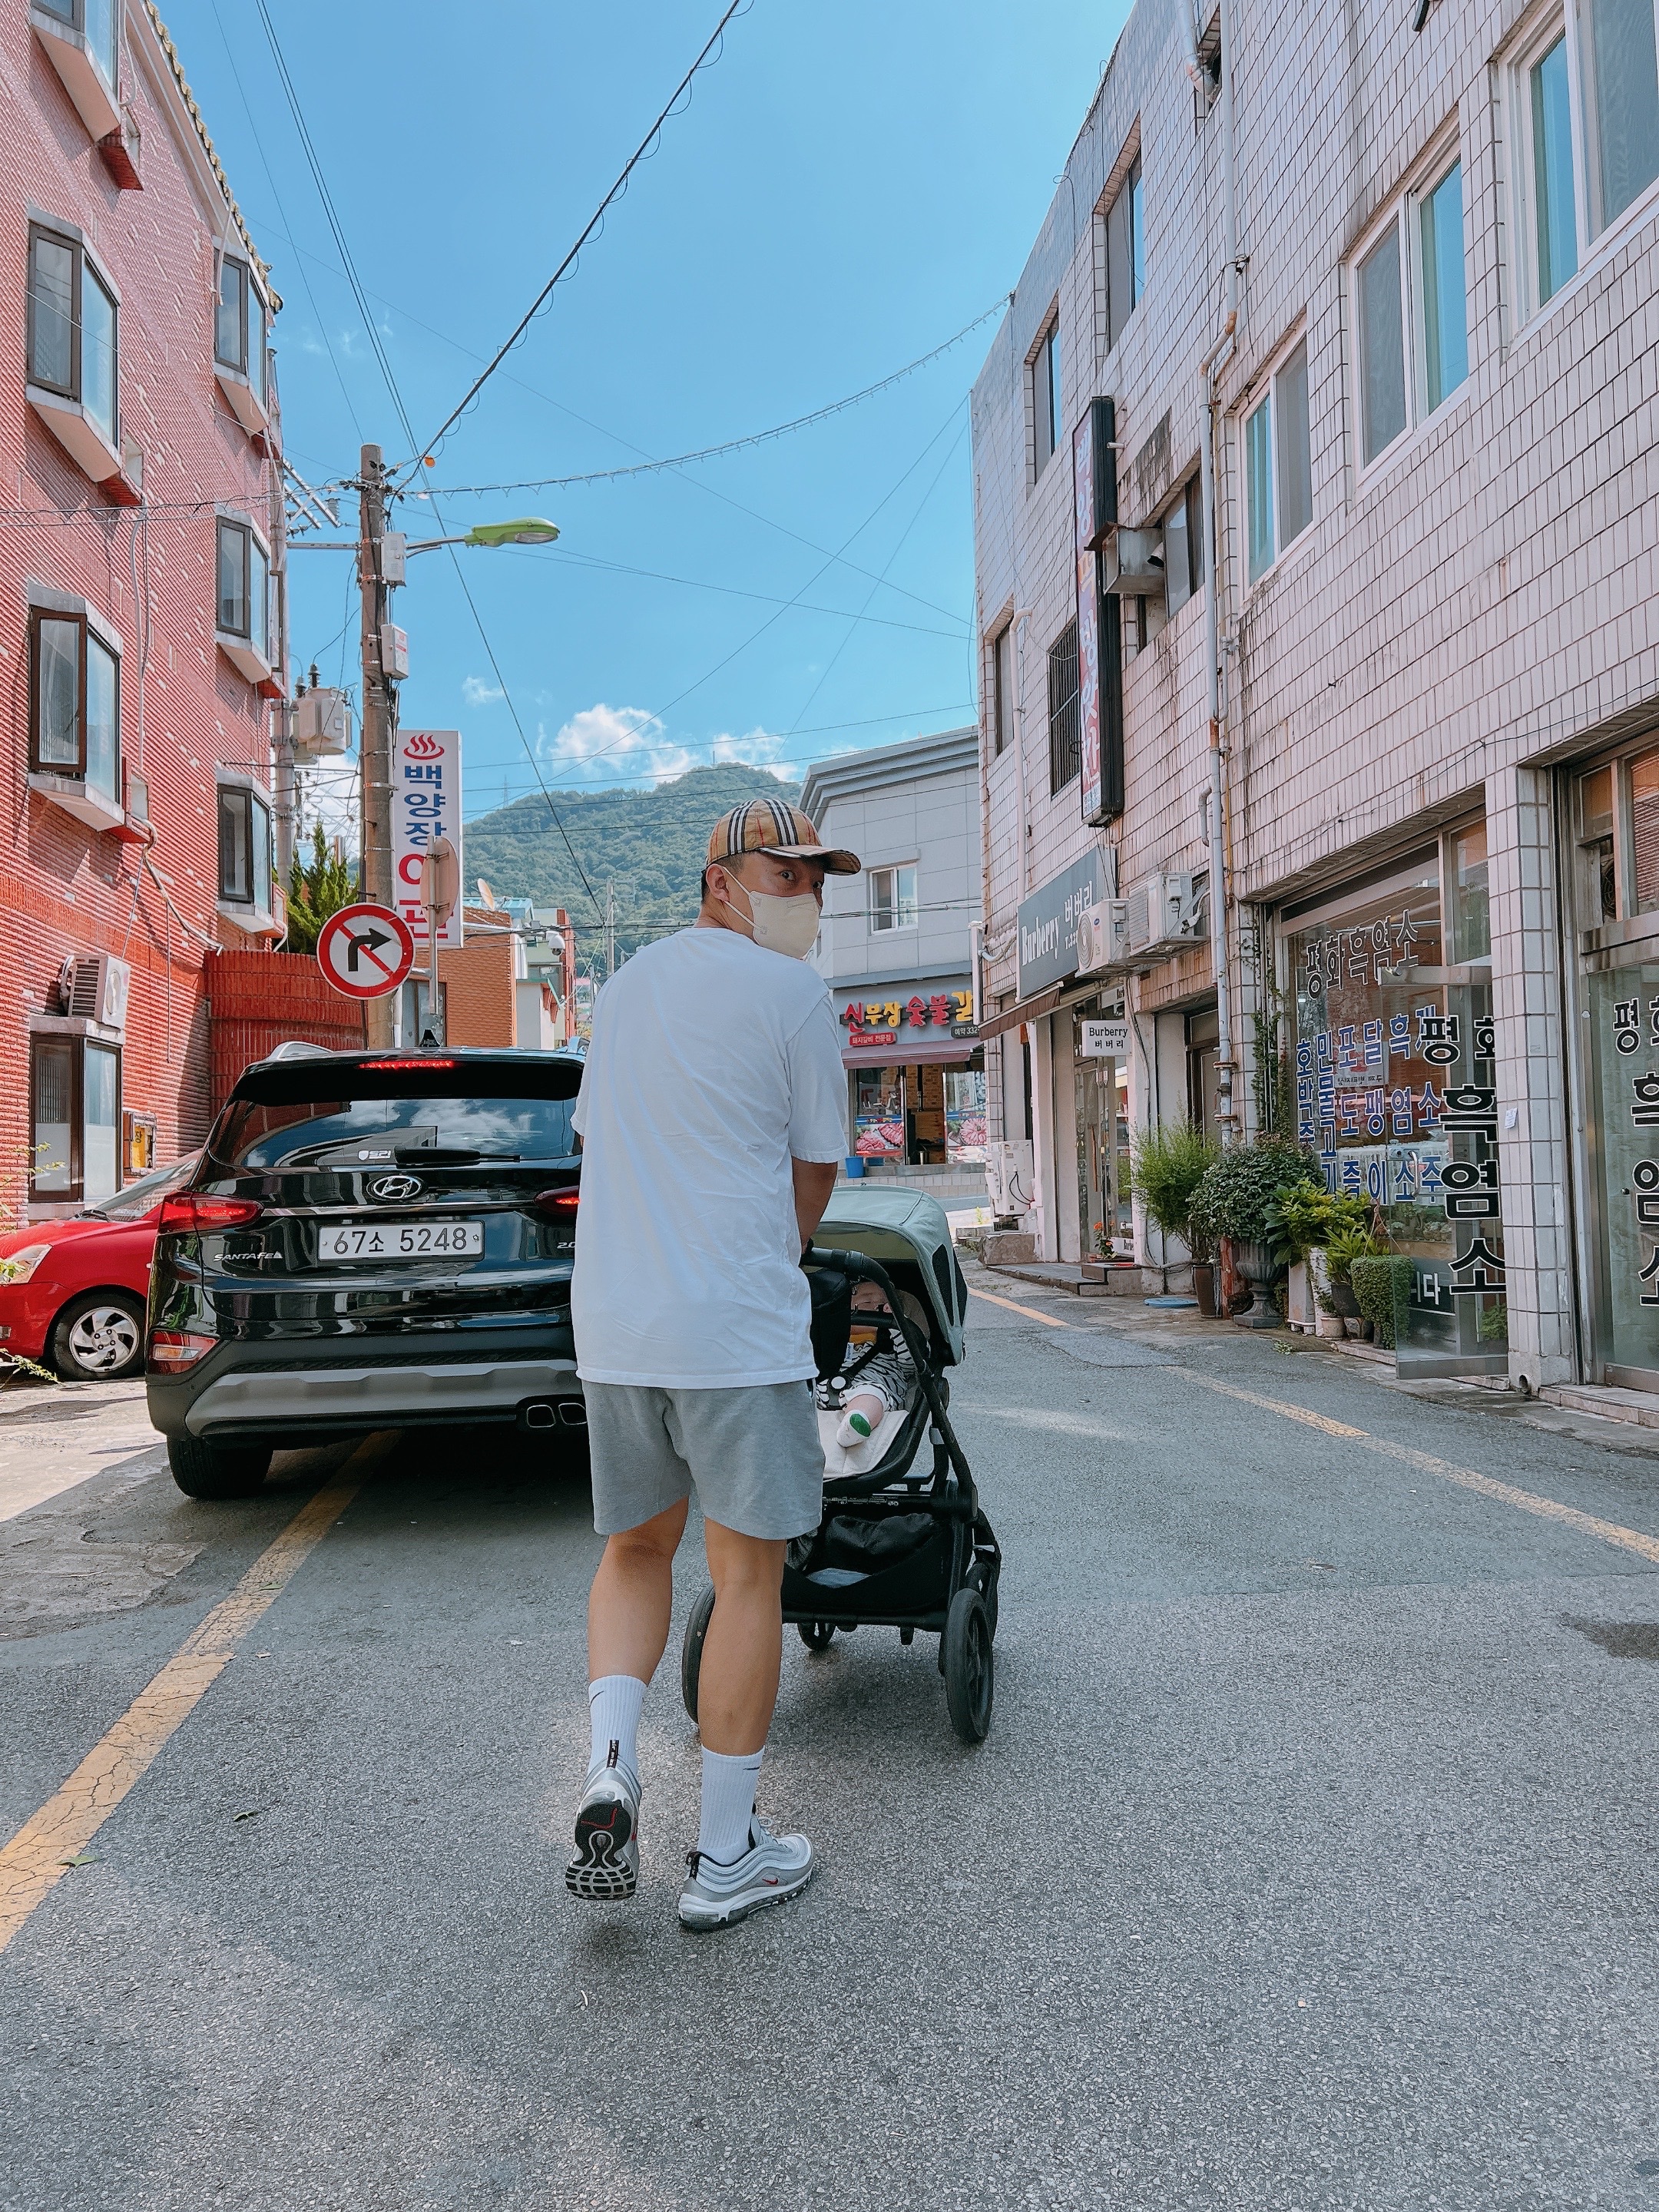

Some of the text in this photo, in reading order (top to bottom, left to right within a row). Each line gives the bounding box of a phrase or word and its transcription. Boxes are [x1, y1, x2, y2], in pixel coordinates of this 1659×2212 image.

[1064, 880, 1093, 929] 버버리
[1021, 915, 1060, 966] Burberry
[1306, 909, 1419, 1000] 평화흑염소
[844, 1001, 903, 1033] 신부장
[1088, 1026, 1128, 1038] Burberry
[1094, 1039, 1124, 1049] 버버리
[333, 1227, 468, 1255] 67소 5248
